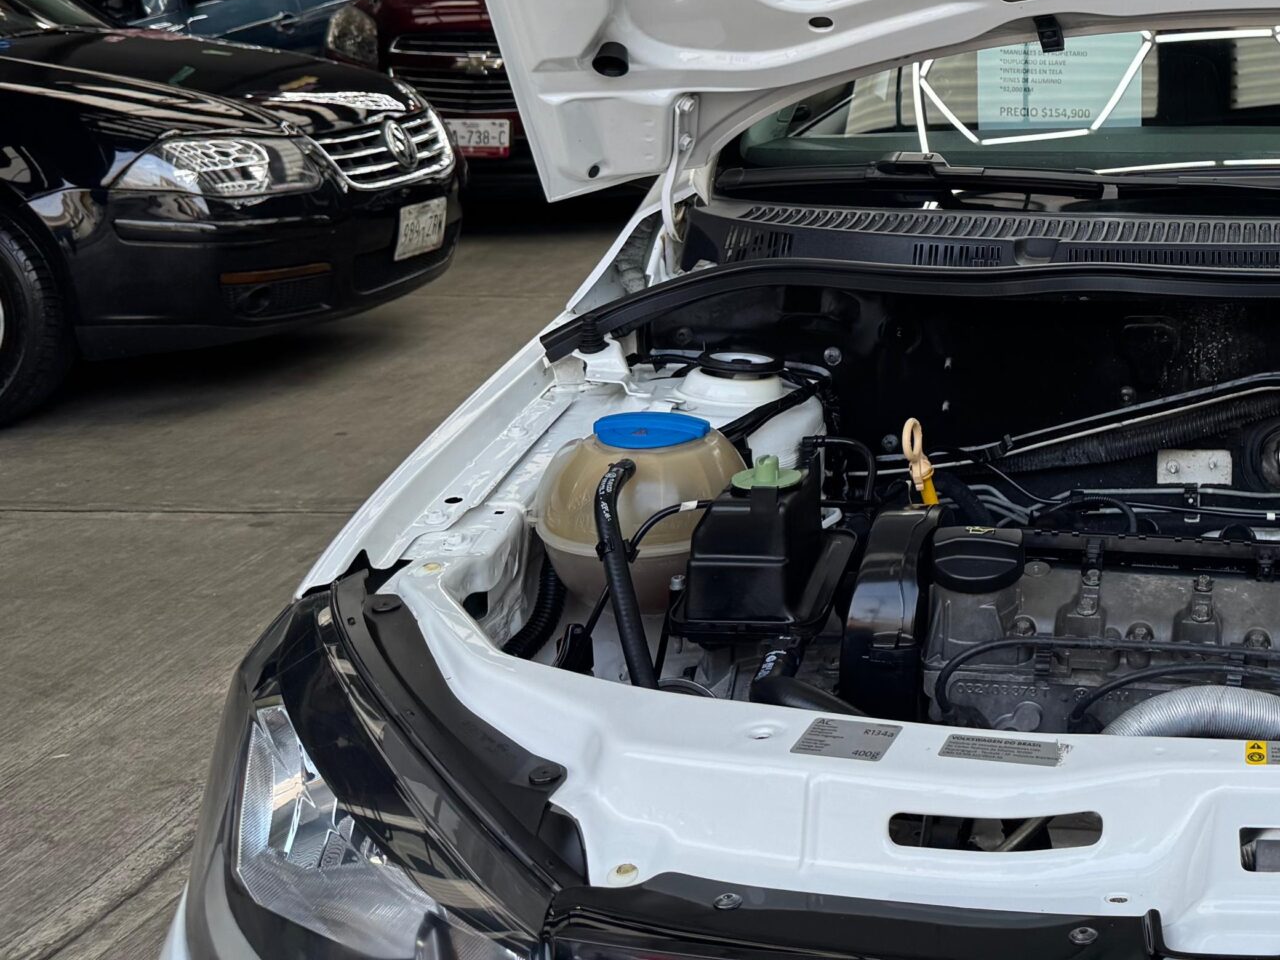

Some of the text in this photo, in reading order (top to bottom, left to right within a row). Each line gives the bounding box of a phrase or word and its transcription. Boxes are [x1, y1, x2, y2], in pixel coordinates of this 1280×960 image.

[999, 107, 1091, 119] PRECIO $154,900
[863, 728, 895, 739] R134a
[951, 735, 1004, 745] VOLKSWAGEN
[851, 749, 881, 760] 400g
